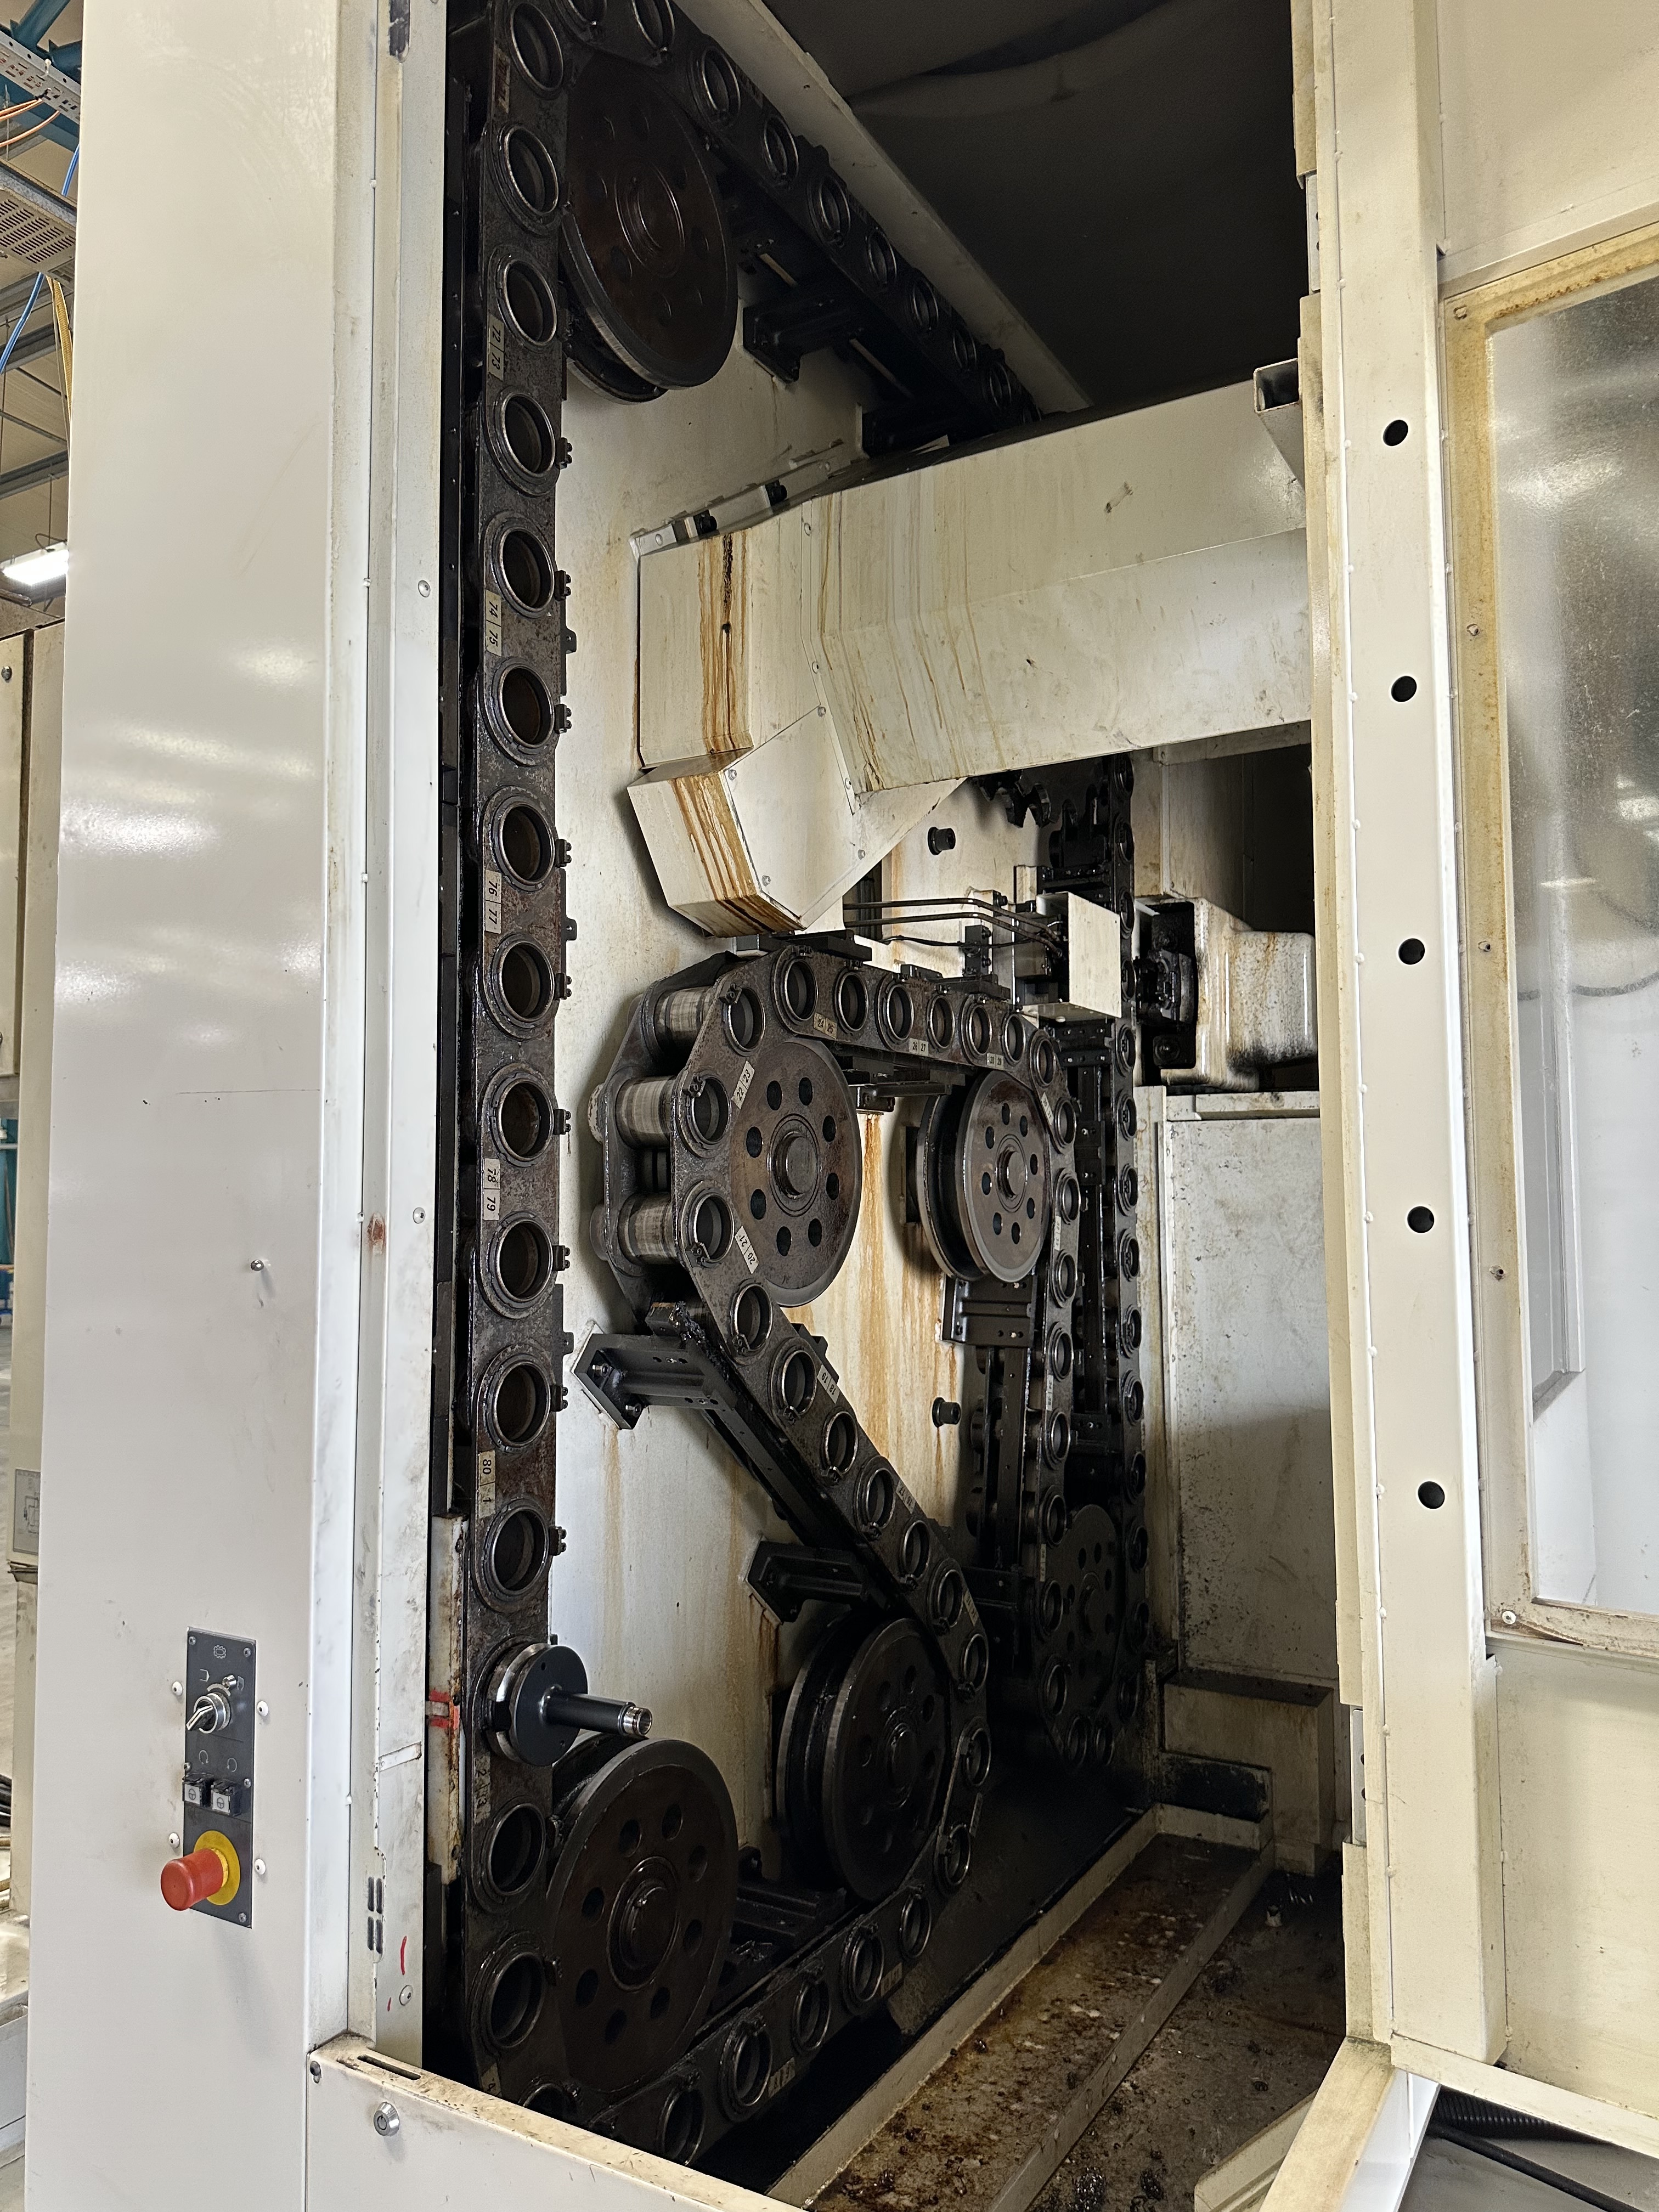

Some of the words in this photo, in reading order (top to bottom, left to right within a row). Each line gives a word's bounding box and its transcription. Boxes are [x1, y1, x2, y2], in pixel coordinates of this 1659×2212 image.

[492, 325, 501, 343] 72
[492, 352, 500, 370] 73
[489, 601, 498, 618] 74
[489, 629, 498, 647] 75
[488, 880, 498, 896] 76
[488, 908, 497, 925] 77
[817, 1018, 824, 1029] 24
[827, 1023, 835, 1034] 25
[912, 1041, 918, 1051] 26
[921, 1043, 926, 1052] 27
[736, 1086, 744, 1101] 22
[743, 1069, 751, 1084] 23
[487, 1168, 496, 1183] 78
[487, 1197, 496, 1211] 79
[740, 1235, 748, 1247] 21
[747, 1252, 755, 1265] 20
[821, 1372, 828, 1384] 19
[829, 1384, 836, 1395] 18
[482, 1459, 492, 1475] 80
[899, 1486, 906, 1497] 17
[478, 1769, 487, 1778] 2
[477, 1798, 487, 1809] 3
